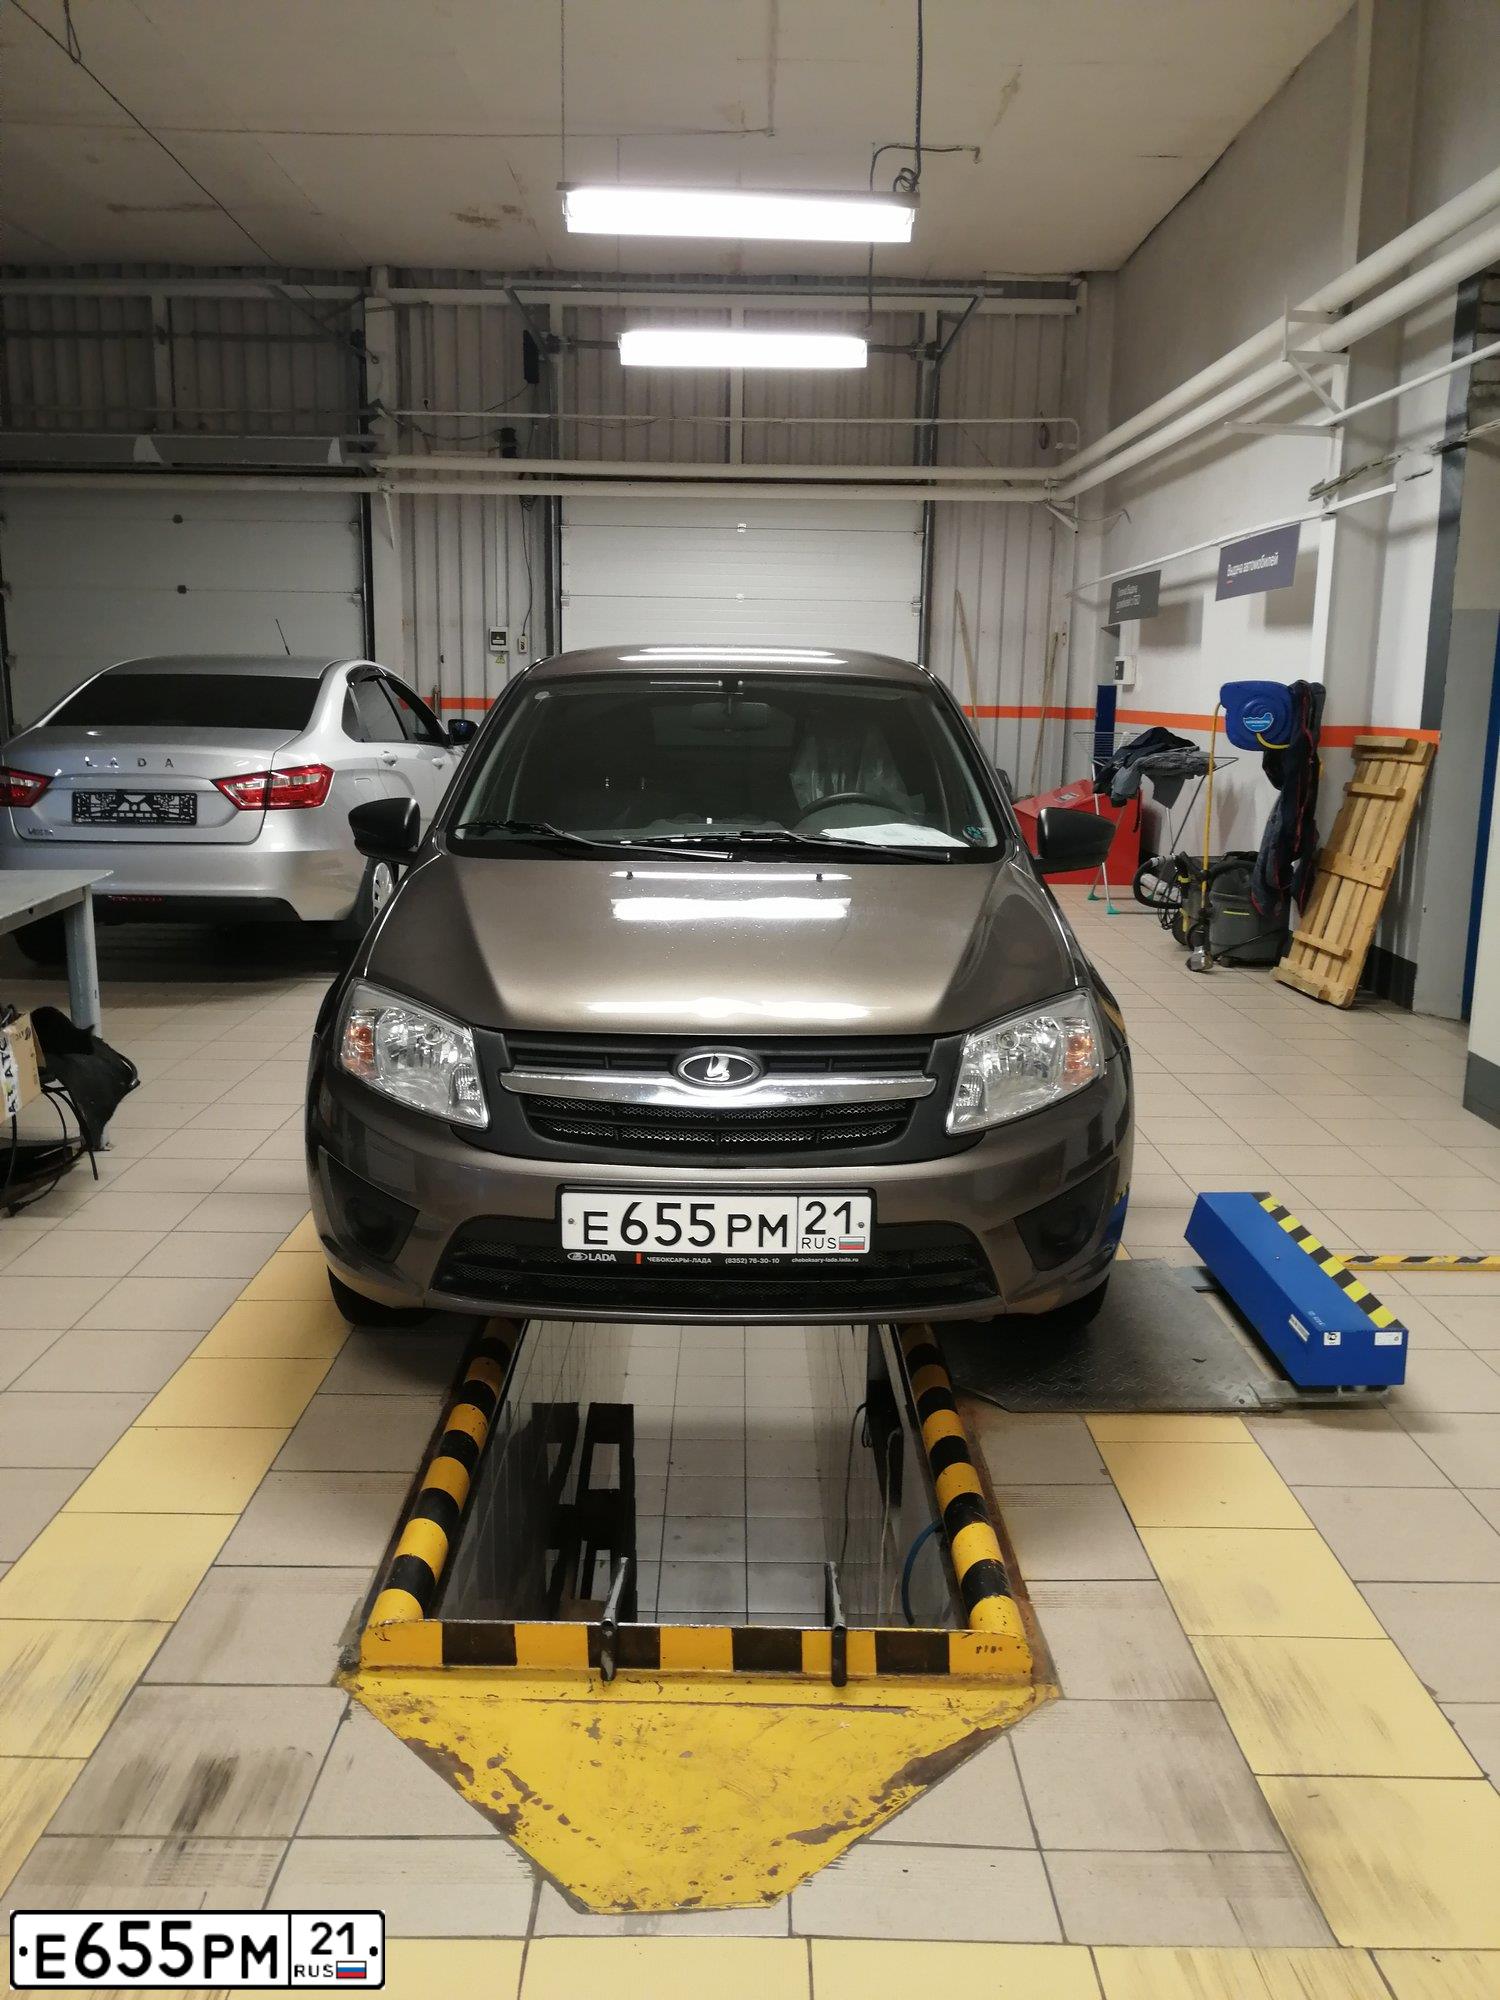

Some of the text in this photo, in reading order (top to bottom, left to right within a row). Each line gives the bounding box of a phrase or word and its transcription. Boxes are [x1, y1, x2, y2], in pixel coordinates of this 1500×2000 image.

[84, 756, 174, 768] LADA
[804, 1201, 852, 1235] 21
[801, 1237, 837, 1250] RUS
[588, 1252, 617, 1262] LADA
[646, 1256, 712, 1264] ЧЕБОКСАРЫ-ЛАДА
[724, 1257, 748, 1265] (8352)
